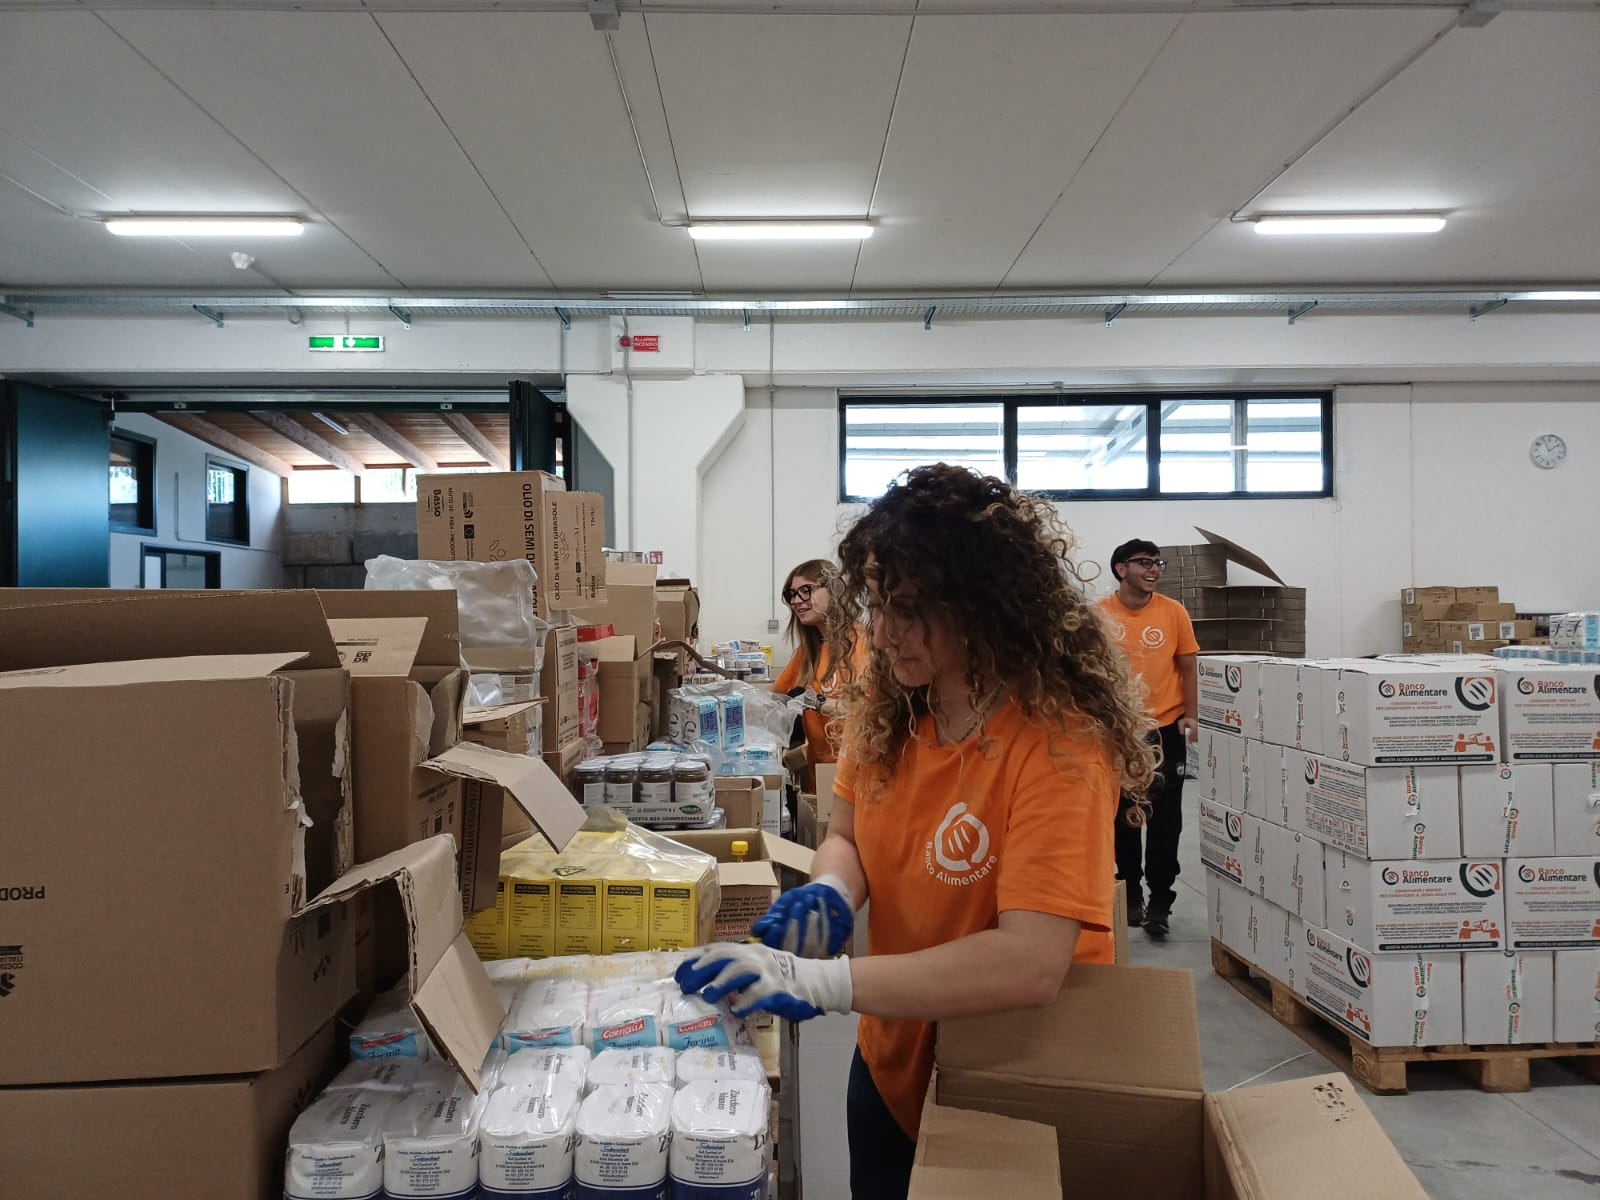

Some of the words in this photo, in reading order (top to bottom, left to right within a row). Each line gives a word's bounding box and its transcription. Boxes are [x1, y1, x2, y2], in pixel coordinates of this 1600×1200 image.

[433, 489, 442, 518] Basso
[522, 483, 533, 508] OLIO
[524, 510, 534, 522] DI
[524, 523, 535, 549] SEMI
[553, 541, 559, 550] DI
[554, 571, 560, 581] DI
[1398, 689, 1448, 697] Alimentare
[925, 841, 935, 875] Banco
[936, 855, 998, 887] Alimentare
[1402, 876, 1452, 884] Alimentare
[1538, 874, 1587, 882] Alimentare
[602, 1020, 644, 1039] CORTICELLA
[683, 1034, 715, 1048] Farina
[444, 1096, 461, 1123] Zucchero
[718, 1092, 729, 1110] bianco
[729, 1089, 740, 1116] Zucchero
[340, 1106, 357, 1125] bianco
[350, 1103, 371, 1130] Zucchero
